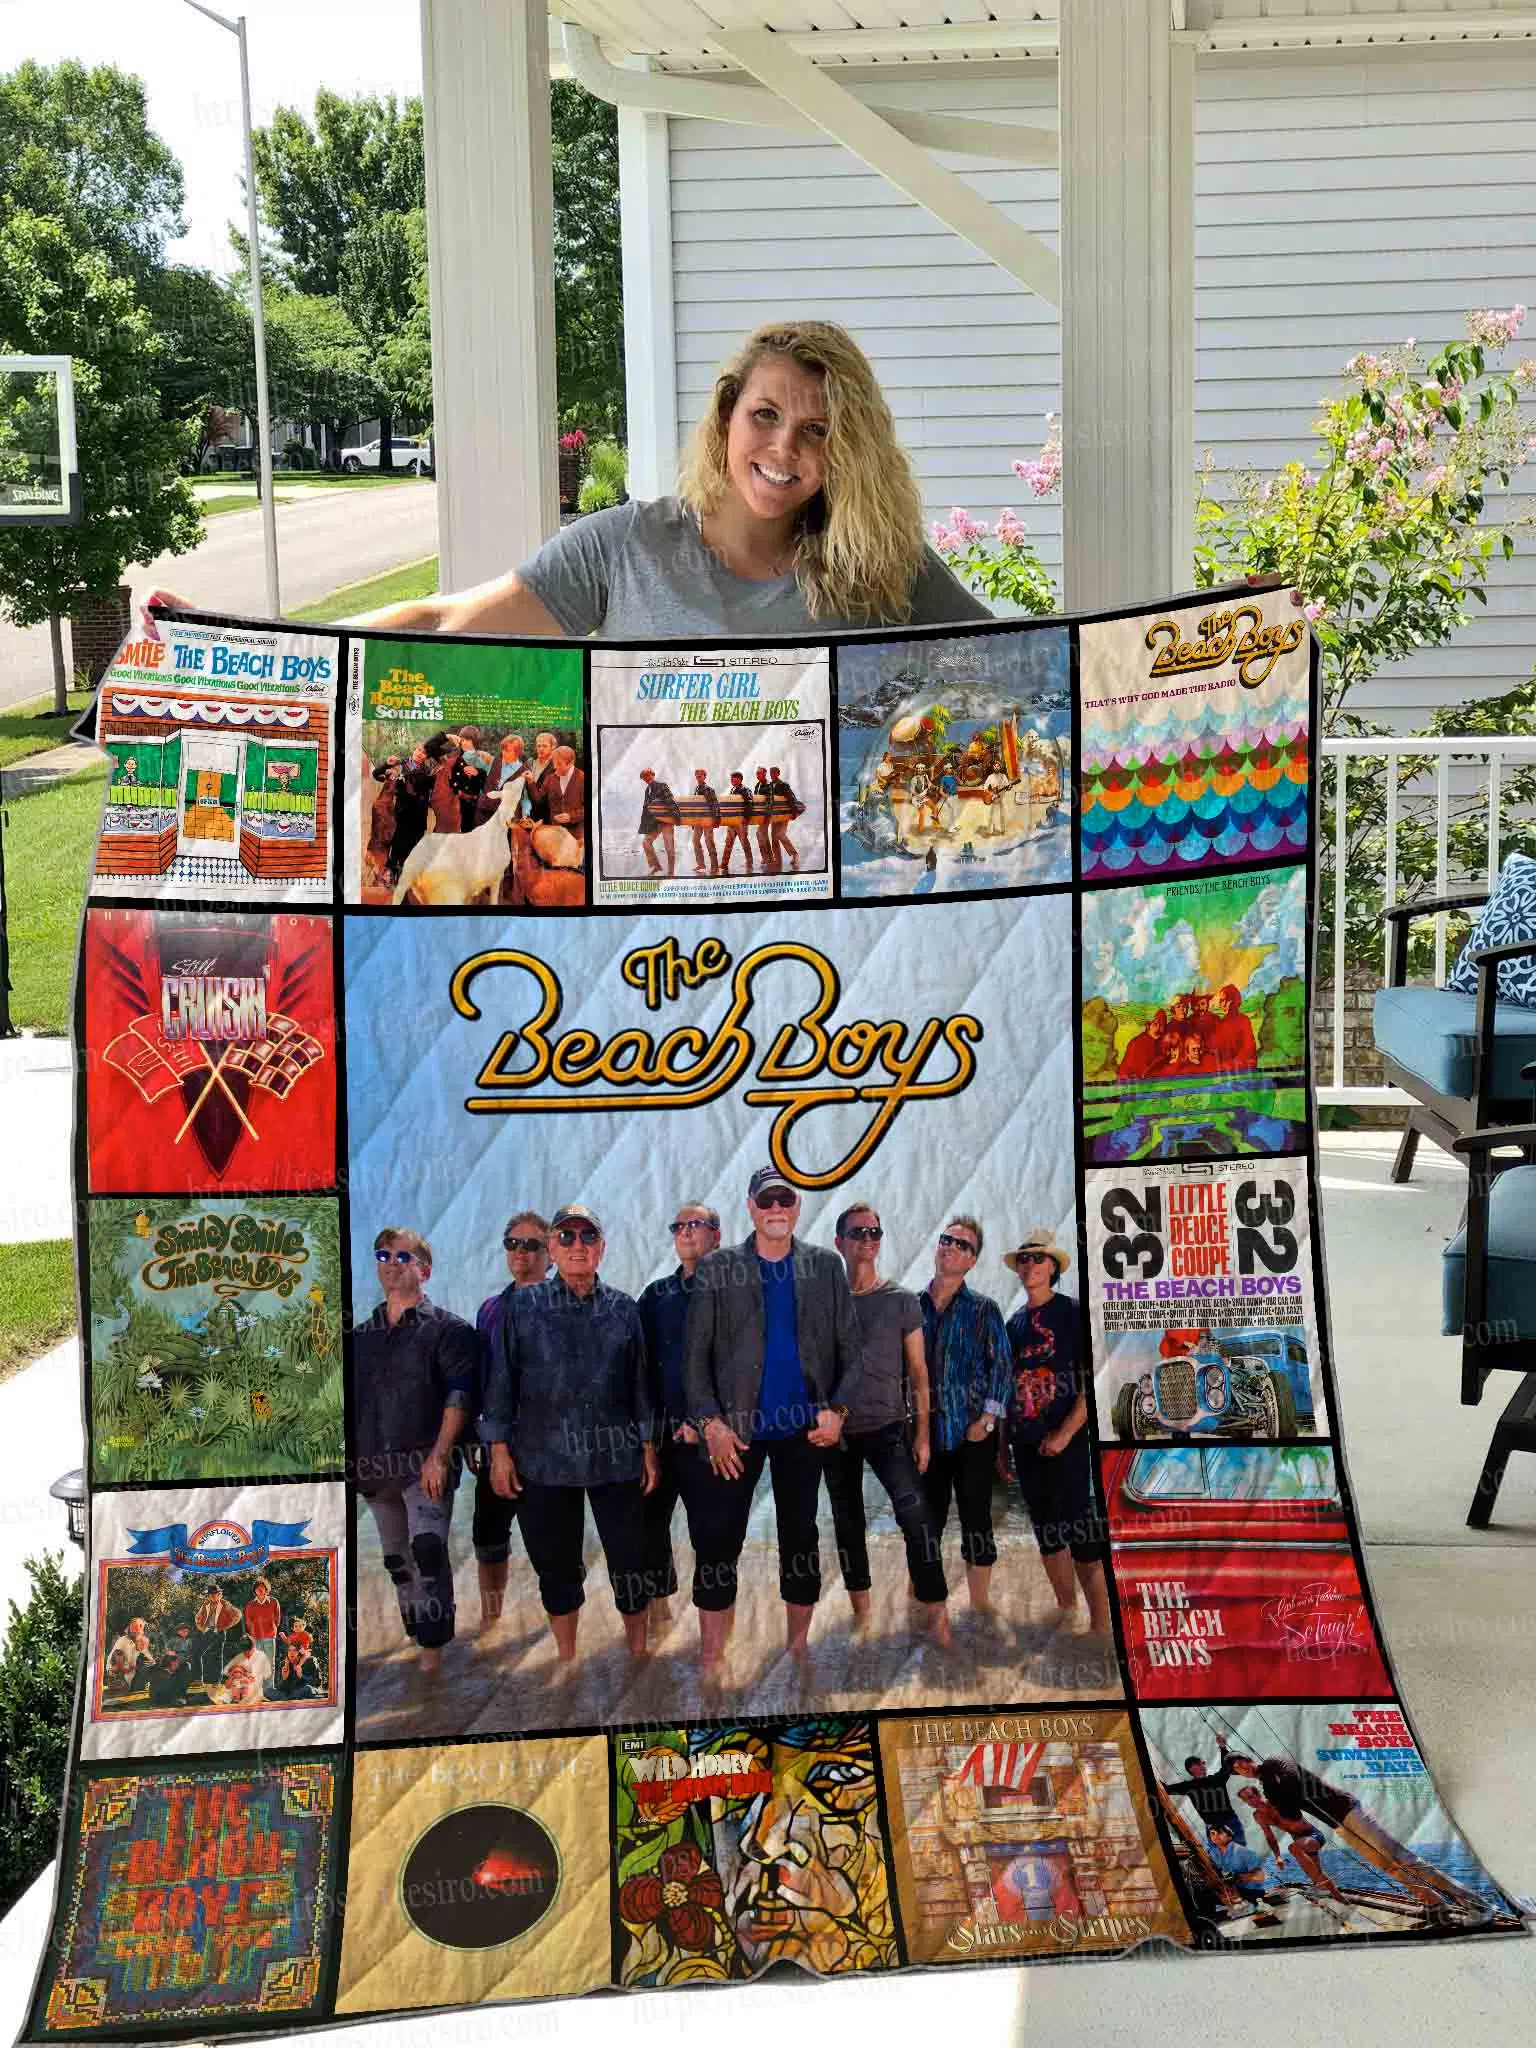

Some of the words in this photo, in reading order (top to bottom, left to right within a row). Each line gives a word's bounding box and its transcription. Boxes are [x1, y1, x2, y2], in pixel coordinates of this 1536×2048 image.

[12, 487, 61, 501] SPALDING
[1198, 610, 1235, 637] The
[728, 656, 778, 666] STEREO
[1145, 620, 1238, 679] Beach
[1232, 605, 1306, 690] Boys
[173, 644, 207, 670] THE
[211, 646, 275, 681] BEACH
[279, 655, 333, 683] BOYS
[388, 667, 426, 683] The
[378, 680, 435, 696] Beach
[637, 672, 714, 700] SURFER
[716, 672, 762, 699] GIRL
[1118, 694, 1140, 705] WHY
[1141, 691, 1160, 701] GOD
[1161, 687, 1188, 698] MADE
[1188, 684, 1207, 694] THE
[1207, 679, 1237, 691] RADIO
[375, 704, 444, 721] Sounds
[413, 694, 442, 708] Pet
[679, 702, 709, 722] THE
[711, 701, 762, 722] BEACH
[763, 699, 801, 721] BOYS
[1222, 878, 1249, 890] BEACH
[1250, 874, 1271, 887] BOYS
[621, 936, 732, 1011] The
[449, 949, 755, 1116] Beach
[735, 942, 985, 1192] Boys
[1217, 1161, 1256, 1172] STEREO
[1168, 1183, 1228, 1215] LITTLE
[1170, 1214, 1231, 1246] DEUCE
[1171, 1245, 1232, 1278] COUPE
[1103, 1280, 1150, 1301] THE
[1155, 1278, 1236, 1300] BEACH
[1241, 1276, 1302, 1297] BOYS
[198, 1527, 241, 1546] SUNFLOWER
[1136, 1581, 1190, 1610] THE
[1141, 1609, 1226, 1639] BEACH
[1145, 1639, 1213, 1667] BOYS
[911, 1723, 954, 1743] THE
[962, 1719, 1032, 1742] BEACH
[1040, 1716, 1096, 1737] BOYS
[1355, 1736, 1414, 1748] BOYS
[624, 1741, 644, 1750] EMI
[628, 1755, 688, 1783] WILD
[688, 1752, 755, 1779] HONEY
[947, 1916, 1023, 1953] Stars
[1050, 1911, 1152, 1945] Stripes
